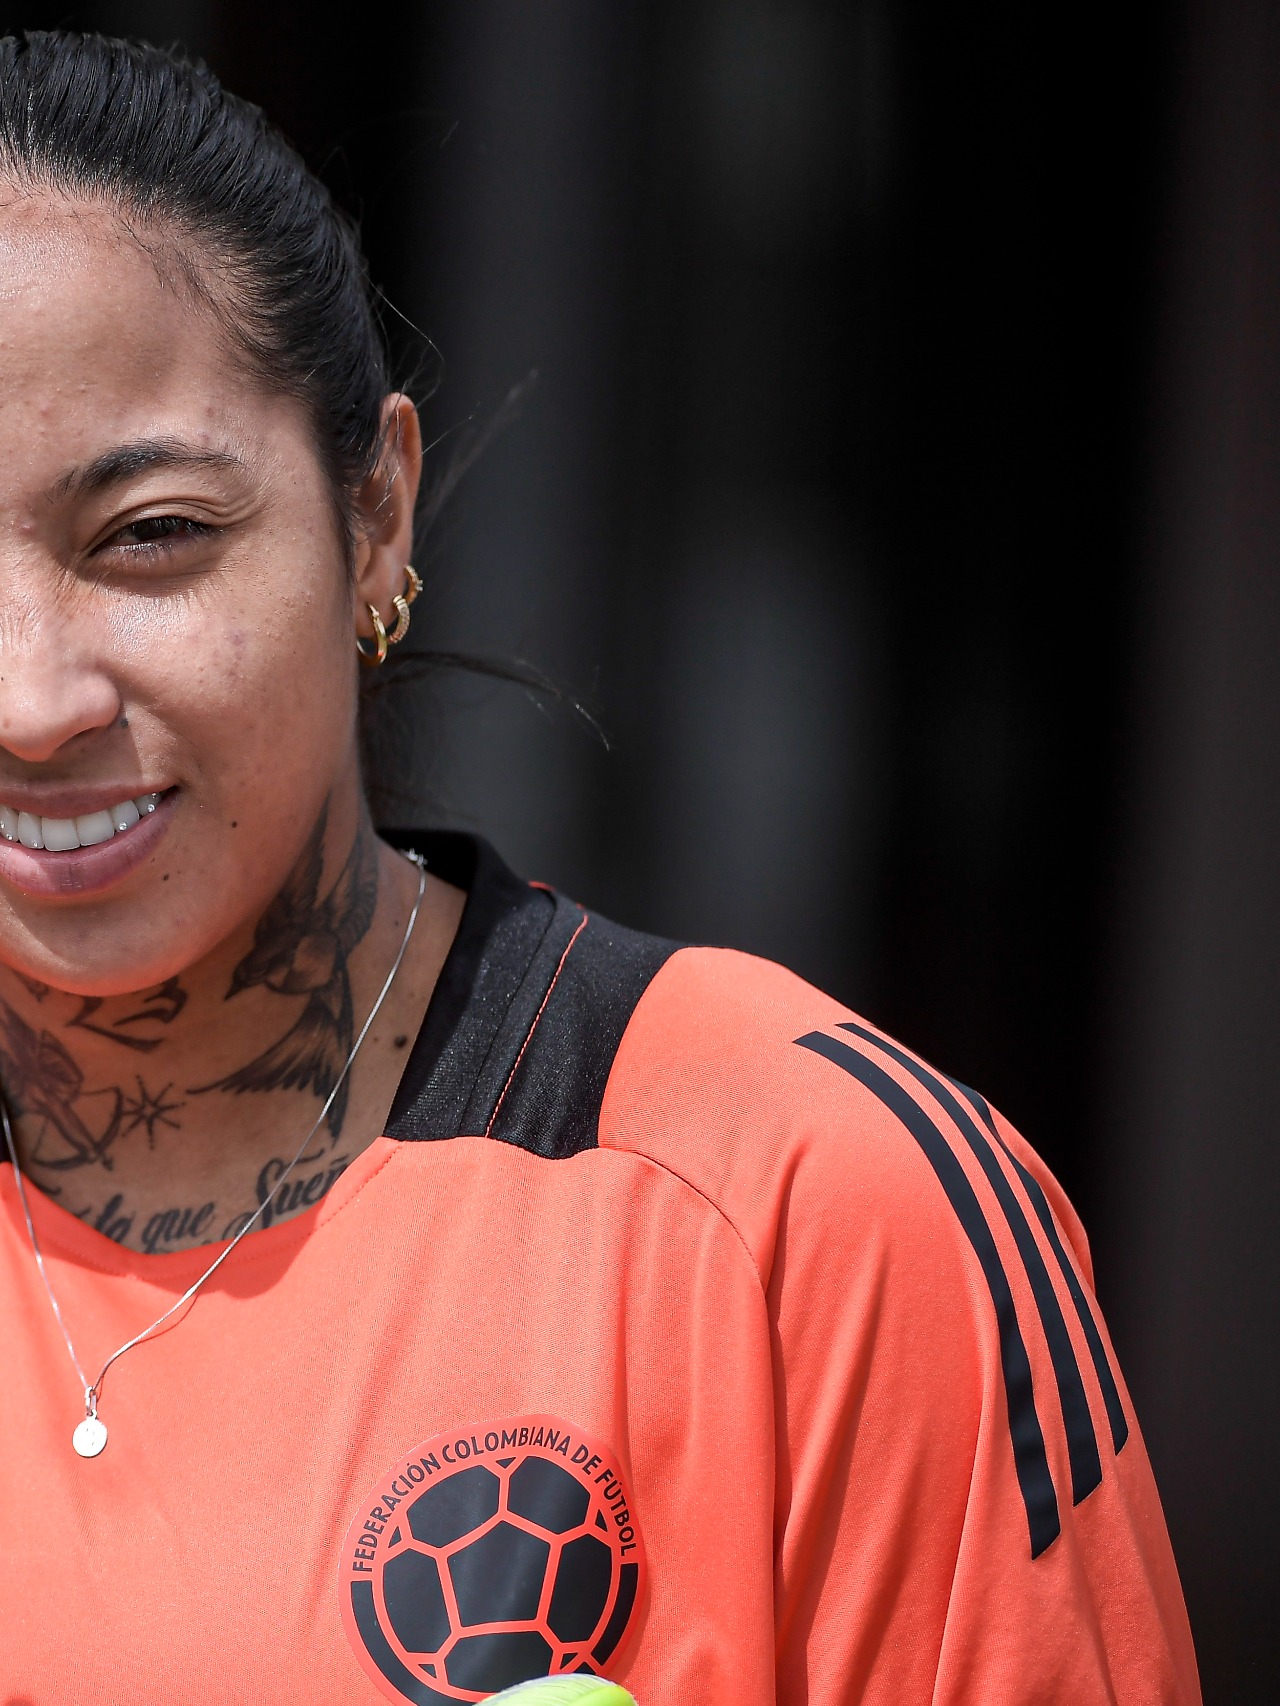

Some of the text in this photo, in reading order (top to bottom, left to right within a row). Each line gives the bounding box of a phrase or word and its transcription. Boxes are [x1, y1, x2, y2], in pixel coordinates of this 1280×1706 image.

[141, 1201, 216, 1254] que
[352, 1426, 638, 1573] FEDERACIÓN COLOMBIANA DE FÚTBOL
